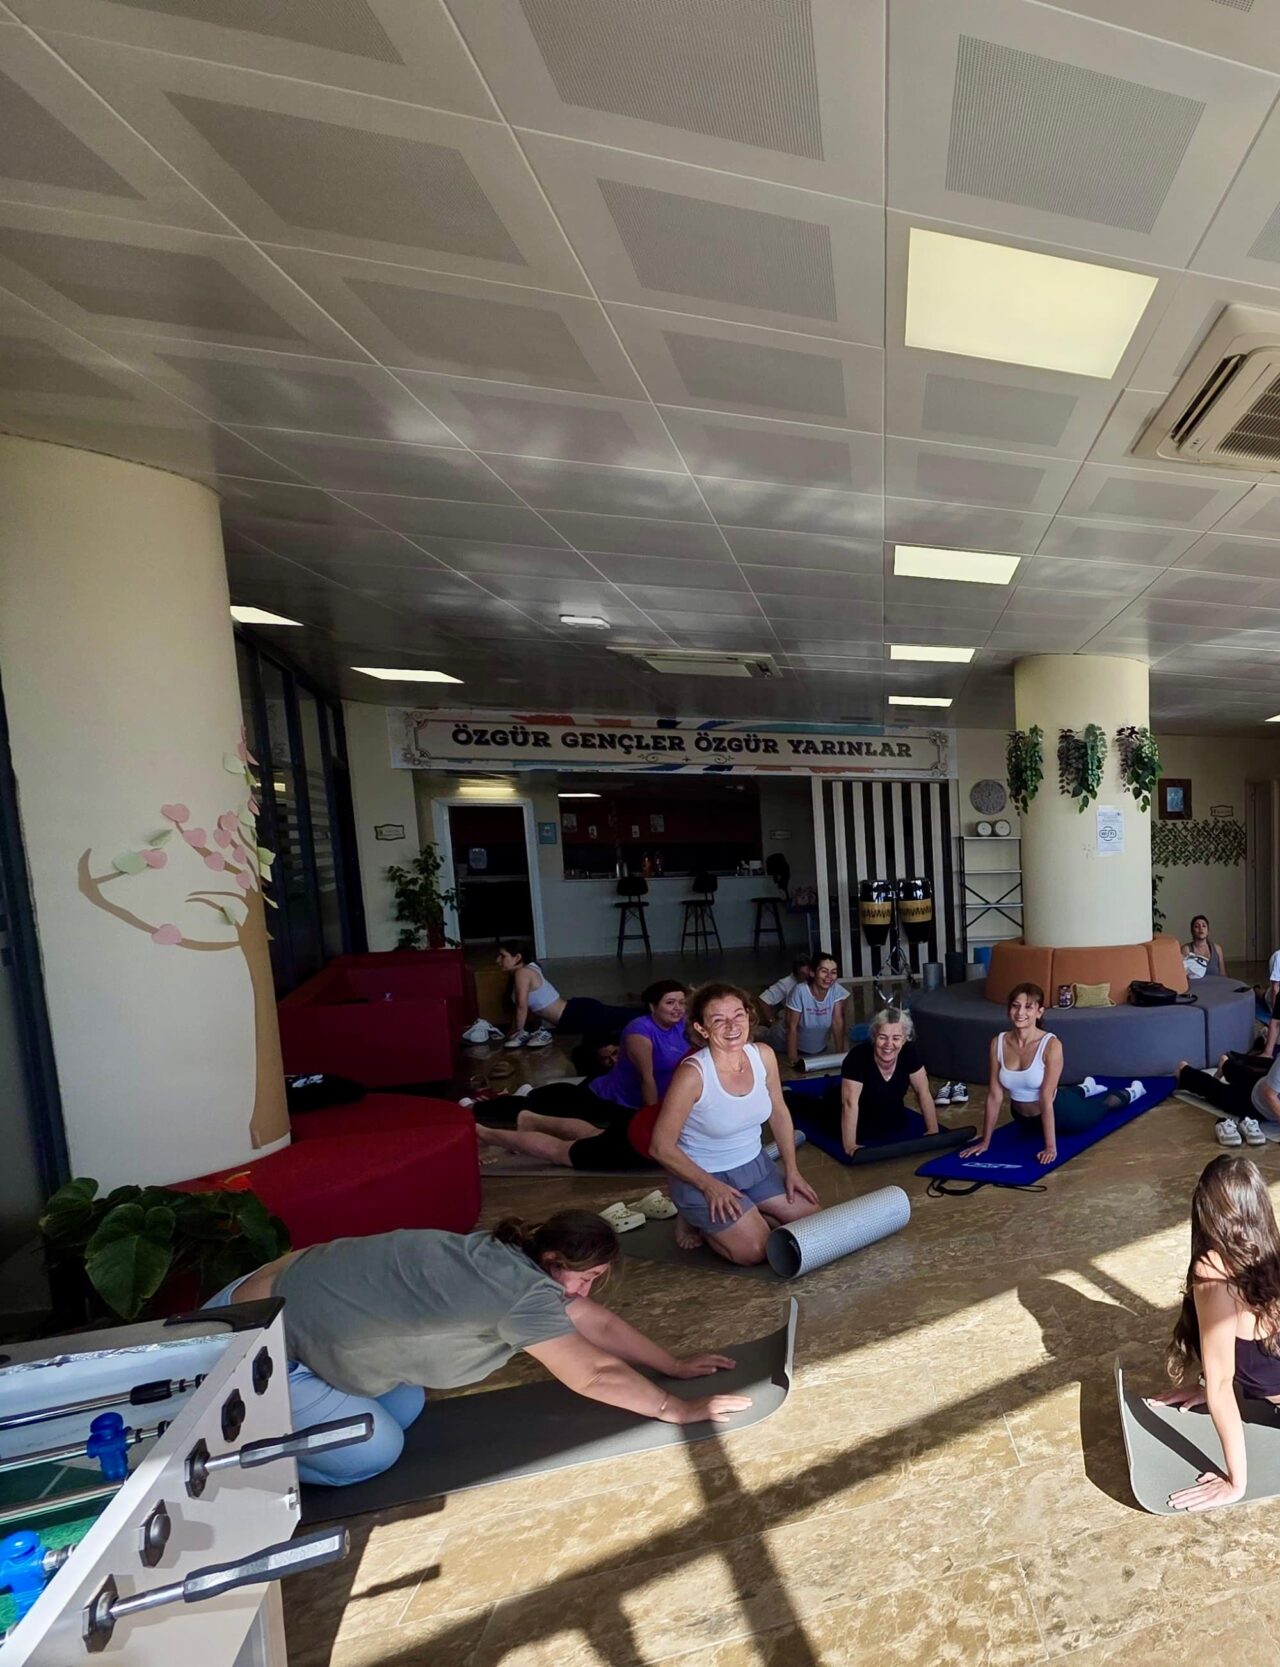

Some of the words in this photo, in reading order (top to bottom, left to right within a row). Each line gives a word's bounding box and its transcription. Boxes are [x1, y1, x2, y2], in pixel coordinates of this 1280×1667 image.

[452, 724, 552, 748] ÖZGÜR
[561, 731, 686, 754] GENÇLER
[694, 732, 779, 754] ÖZGÜR
[787, 738, 912, 758] YARINLAR
